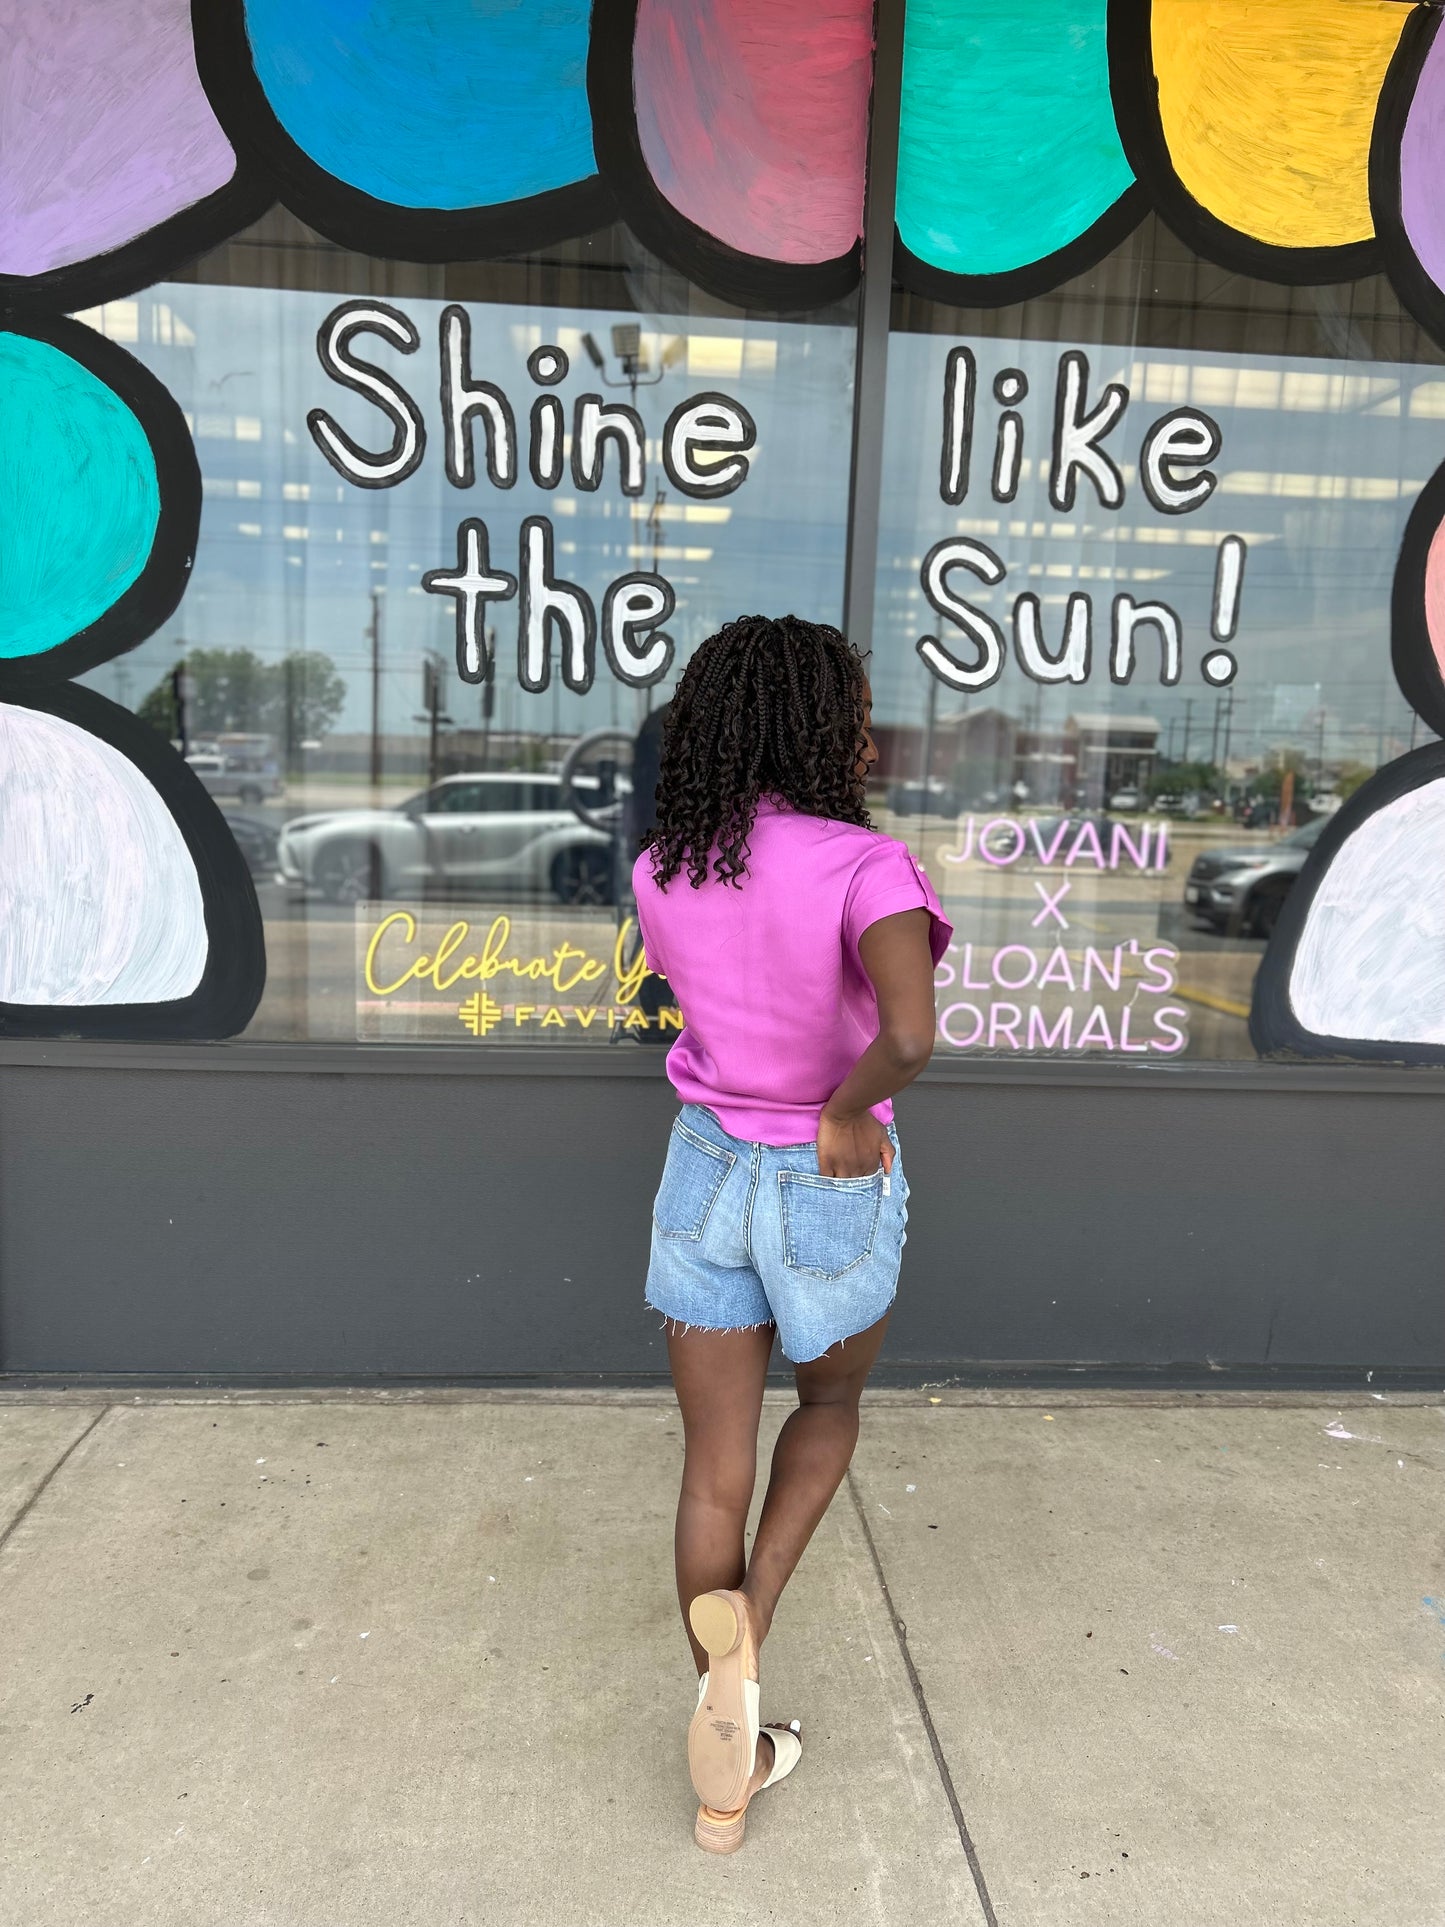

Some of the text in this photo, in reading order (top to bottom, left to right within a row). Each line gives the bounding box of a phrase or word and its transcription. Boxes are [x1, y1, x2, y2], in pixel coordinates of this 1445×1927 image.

[307, 299, 1222, 515] Shine like
[421, 515, 1247, 695] the Sun!
[945, 817, 1168, 871] JOVANI
[1031, 881, 1072, 929] X
[365, 911, 606, 997] Celebrate
[934, 938, 1176, 993] SLOAN'S
[934, 1001, 1187, 1052] ORMALS
